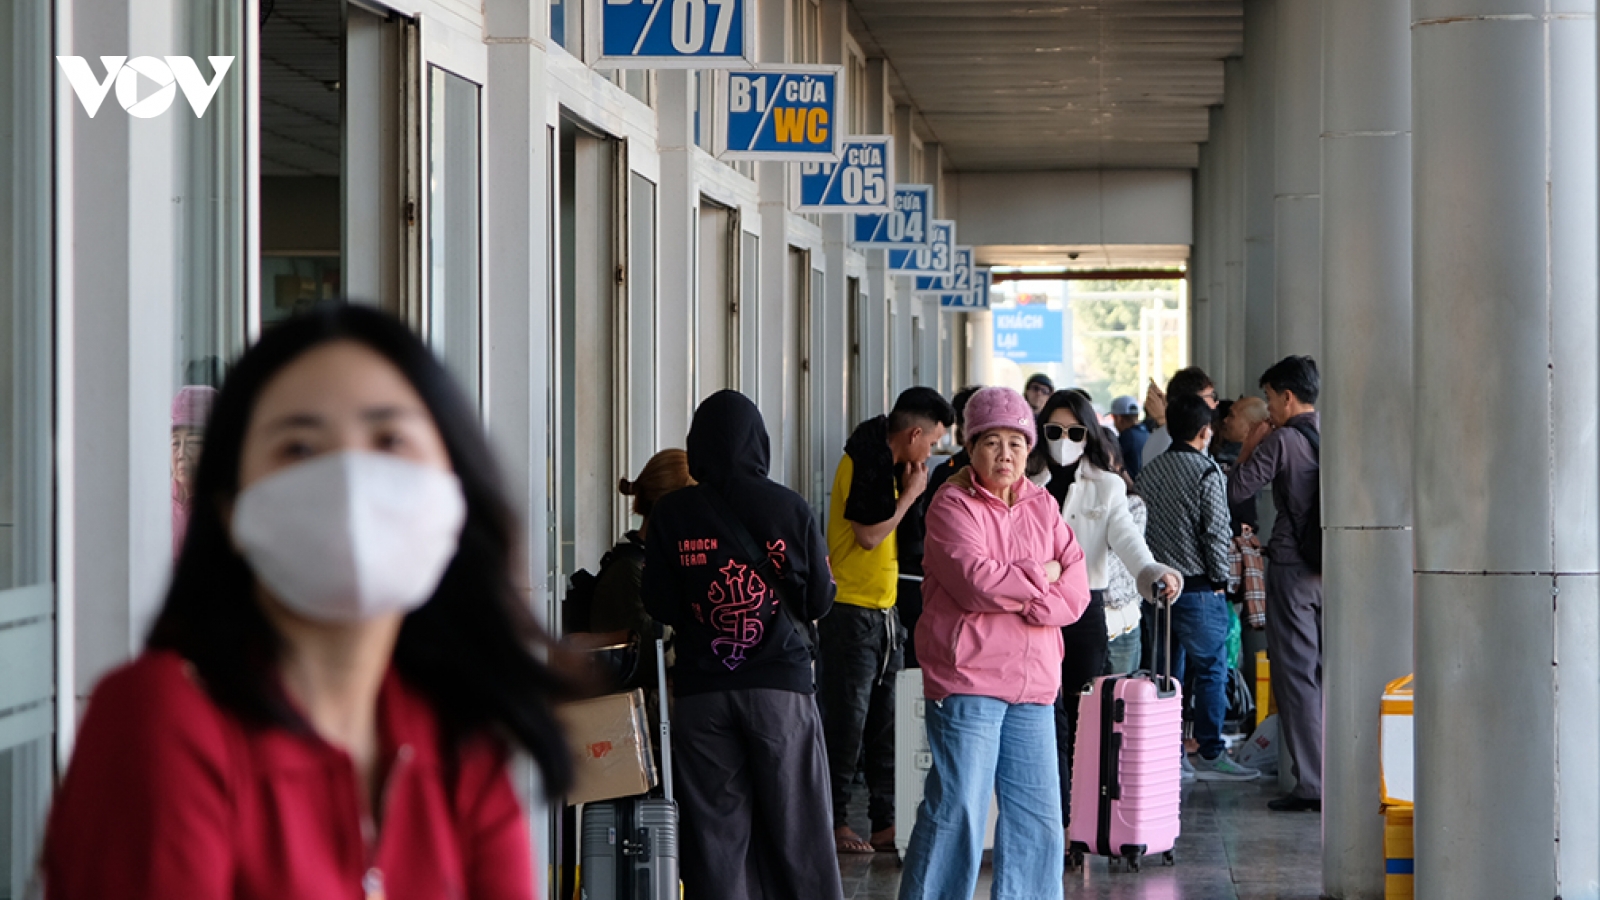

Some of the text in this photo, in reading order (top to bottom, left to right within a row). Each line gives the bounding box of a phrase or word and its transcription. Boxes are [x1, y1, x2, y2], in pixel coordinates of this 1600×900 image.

[671, 0, 735, 53] 07
[730, 75, 826, 112] B1 CỬA
[774, 107, 828, 143] WC
[848, 143, 882, 165] CỬA
[842, 167, 885, 204] 05
[887, 211, 924, 242] 04
[680, 553, 708, 567] TEAM
